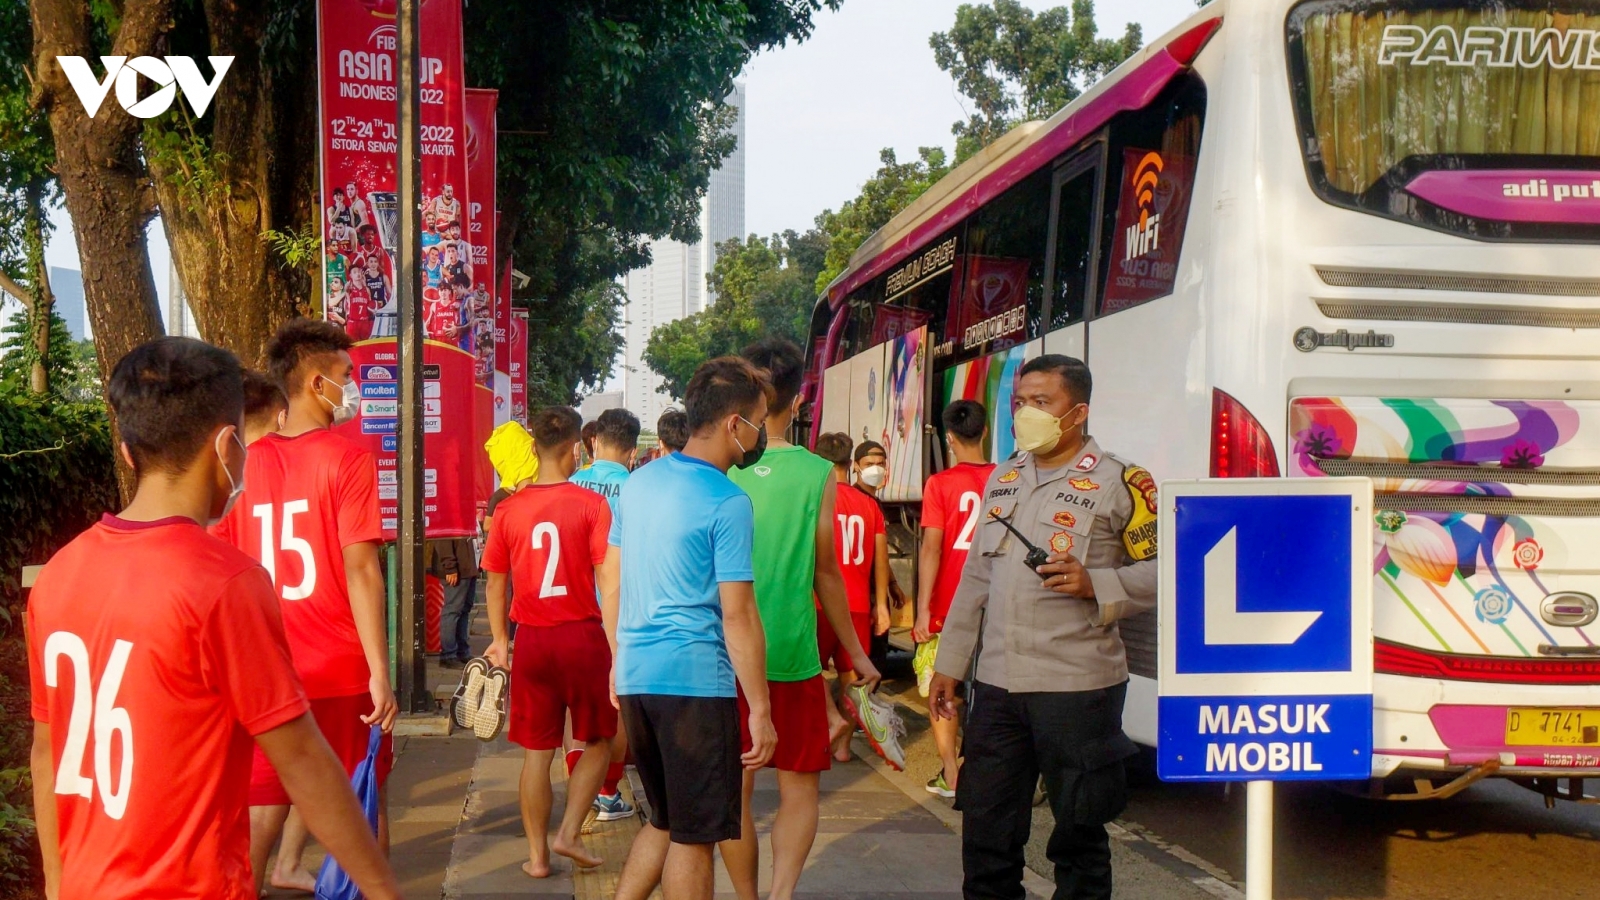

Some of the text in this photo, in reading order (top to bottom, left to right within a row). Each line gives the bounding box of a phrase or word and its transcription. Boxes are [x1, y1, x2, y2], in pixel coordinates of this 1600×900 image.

[376, 35, 397, 50] FIB
[338, 49, 443, 84] ASIA UP
[340, 82, 444, 105] INDONESI 022
[331, 137, 455, 156] ISTORA SENAY AKARTA
[420, 125, 454, 143] 2022
[1126, 213, 1160, 261] WiFi
[374, 353, 395, 361] GLOBAL
[364, 386, 396, 395] molten
[374, 404, 396, 412] Smart
[1055, 492, 1096, 510] POLRI
[952, 491, 981, 550] 2
[252, 498, 317, 601] 15
[837, 513, 865, 566] 10
[532, 521, 568, 599] 2
[44, 631, 134, 820] 26
[1198, 704, 1330, 735] MASUK
[1510, 711, 1582, 733] D 7741
[1205, 743, 1322, 773] MOBIL
